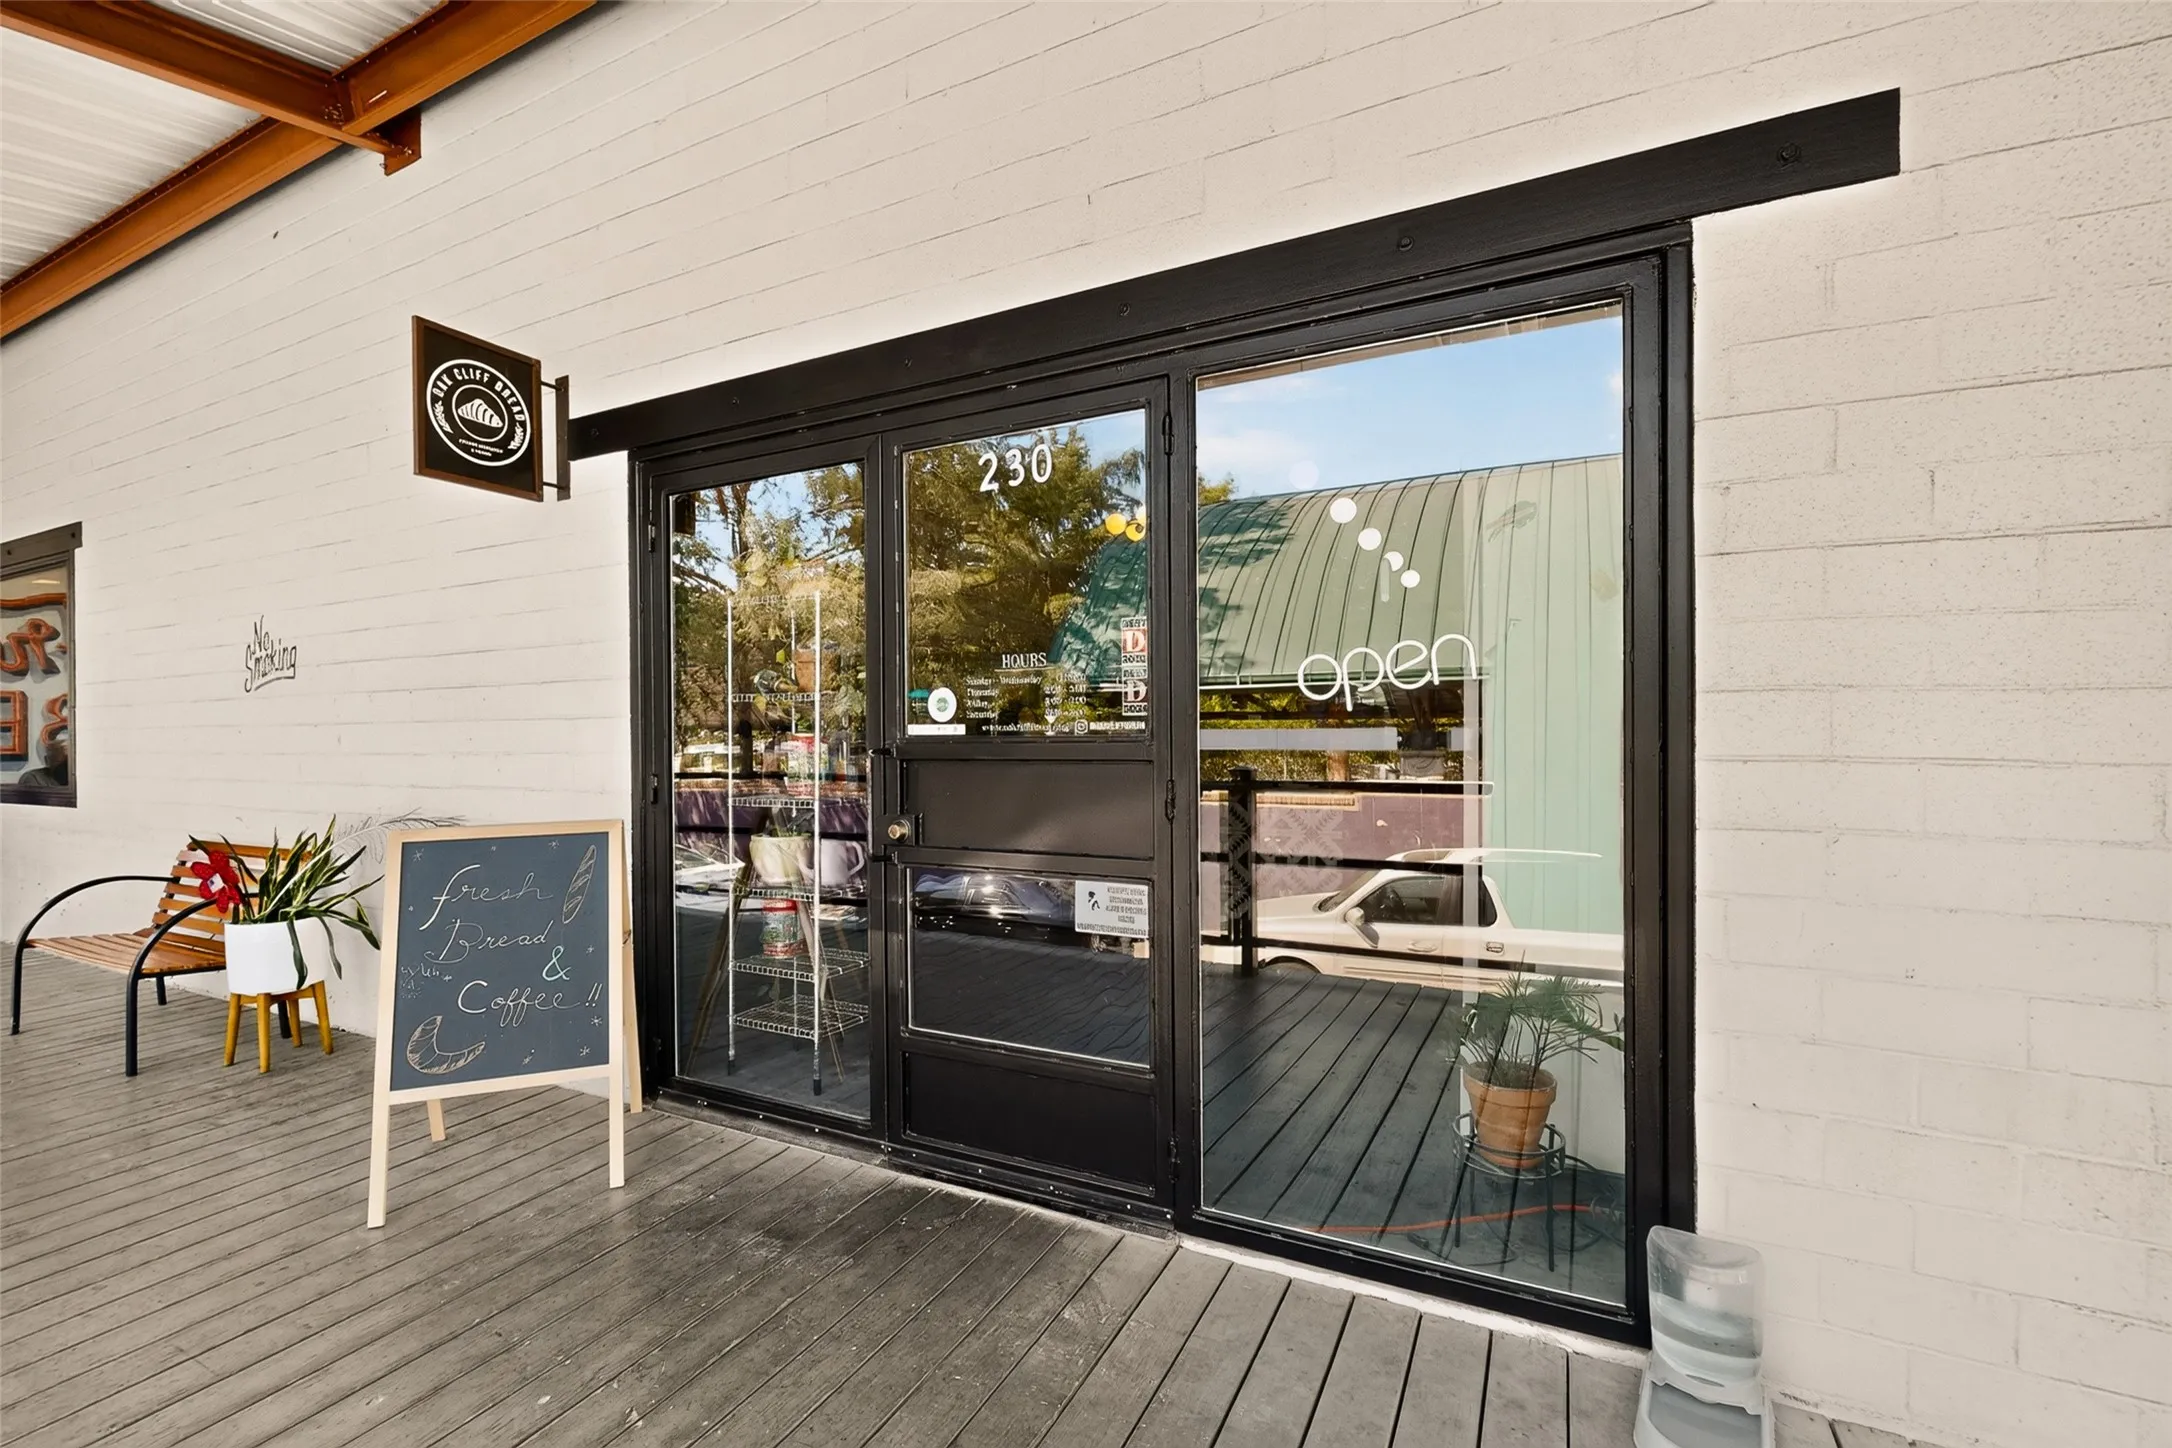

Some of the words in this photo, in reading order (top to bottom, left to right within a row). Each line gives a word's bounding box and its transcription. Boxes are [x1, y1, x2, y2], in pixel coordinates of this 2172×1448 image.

[432, 373, 453, 398] OAK
[453, 367, 490, 383] CLIFF
[494, 380, 526, 421] BREAD
[977, 443, 1052, 493] 230
[252, 614, 269, 655] No
[244, 638, 297, 693] Smoking
[1001, 652, 1047, 668] HOURS
[1297, 633, 1478, 712] open
[424, 918, 554, 964] Bread
[542, 945, 572, 981] &
[457, 980, 581, 1028] Coffee
